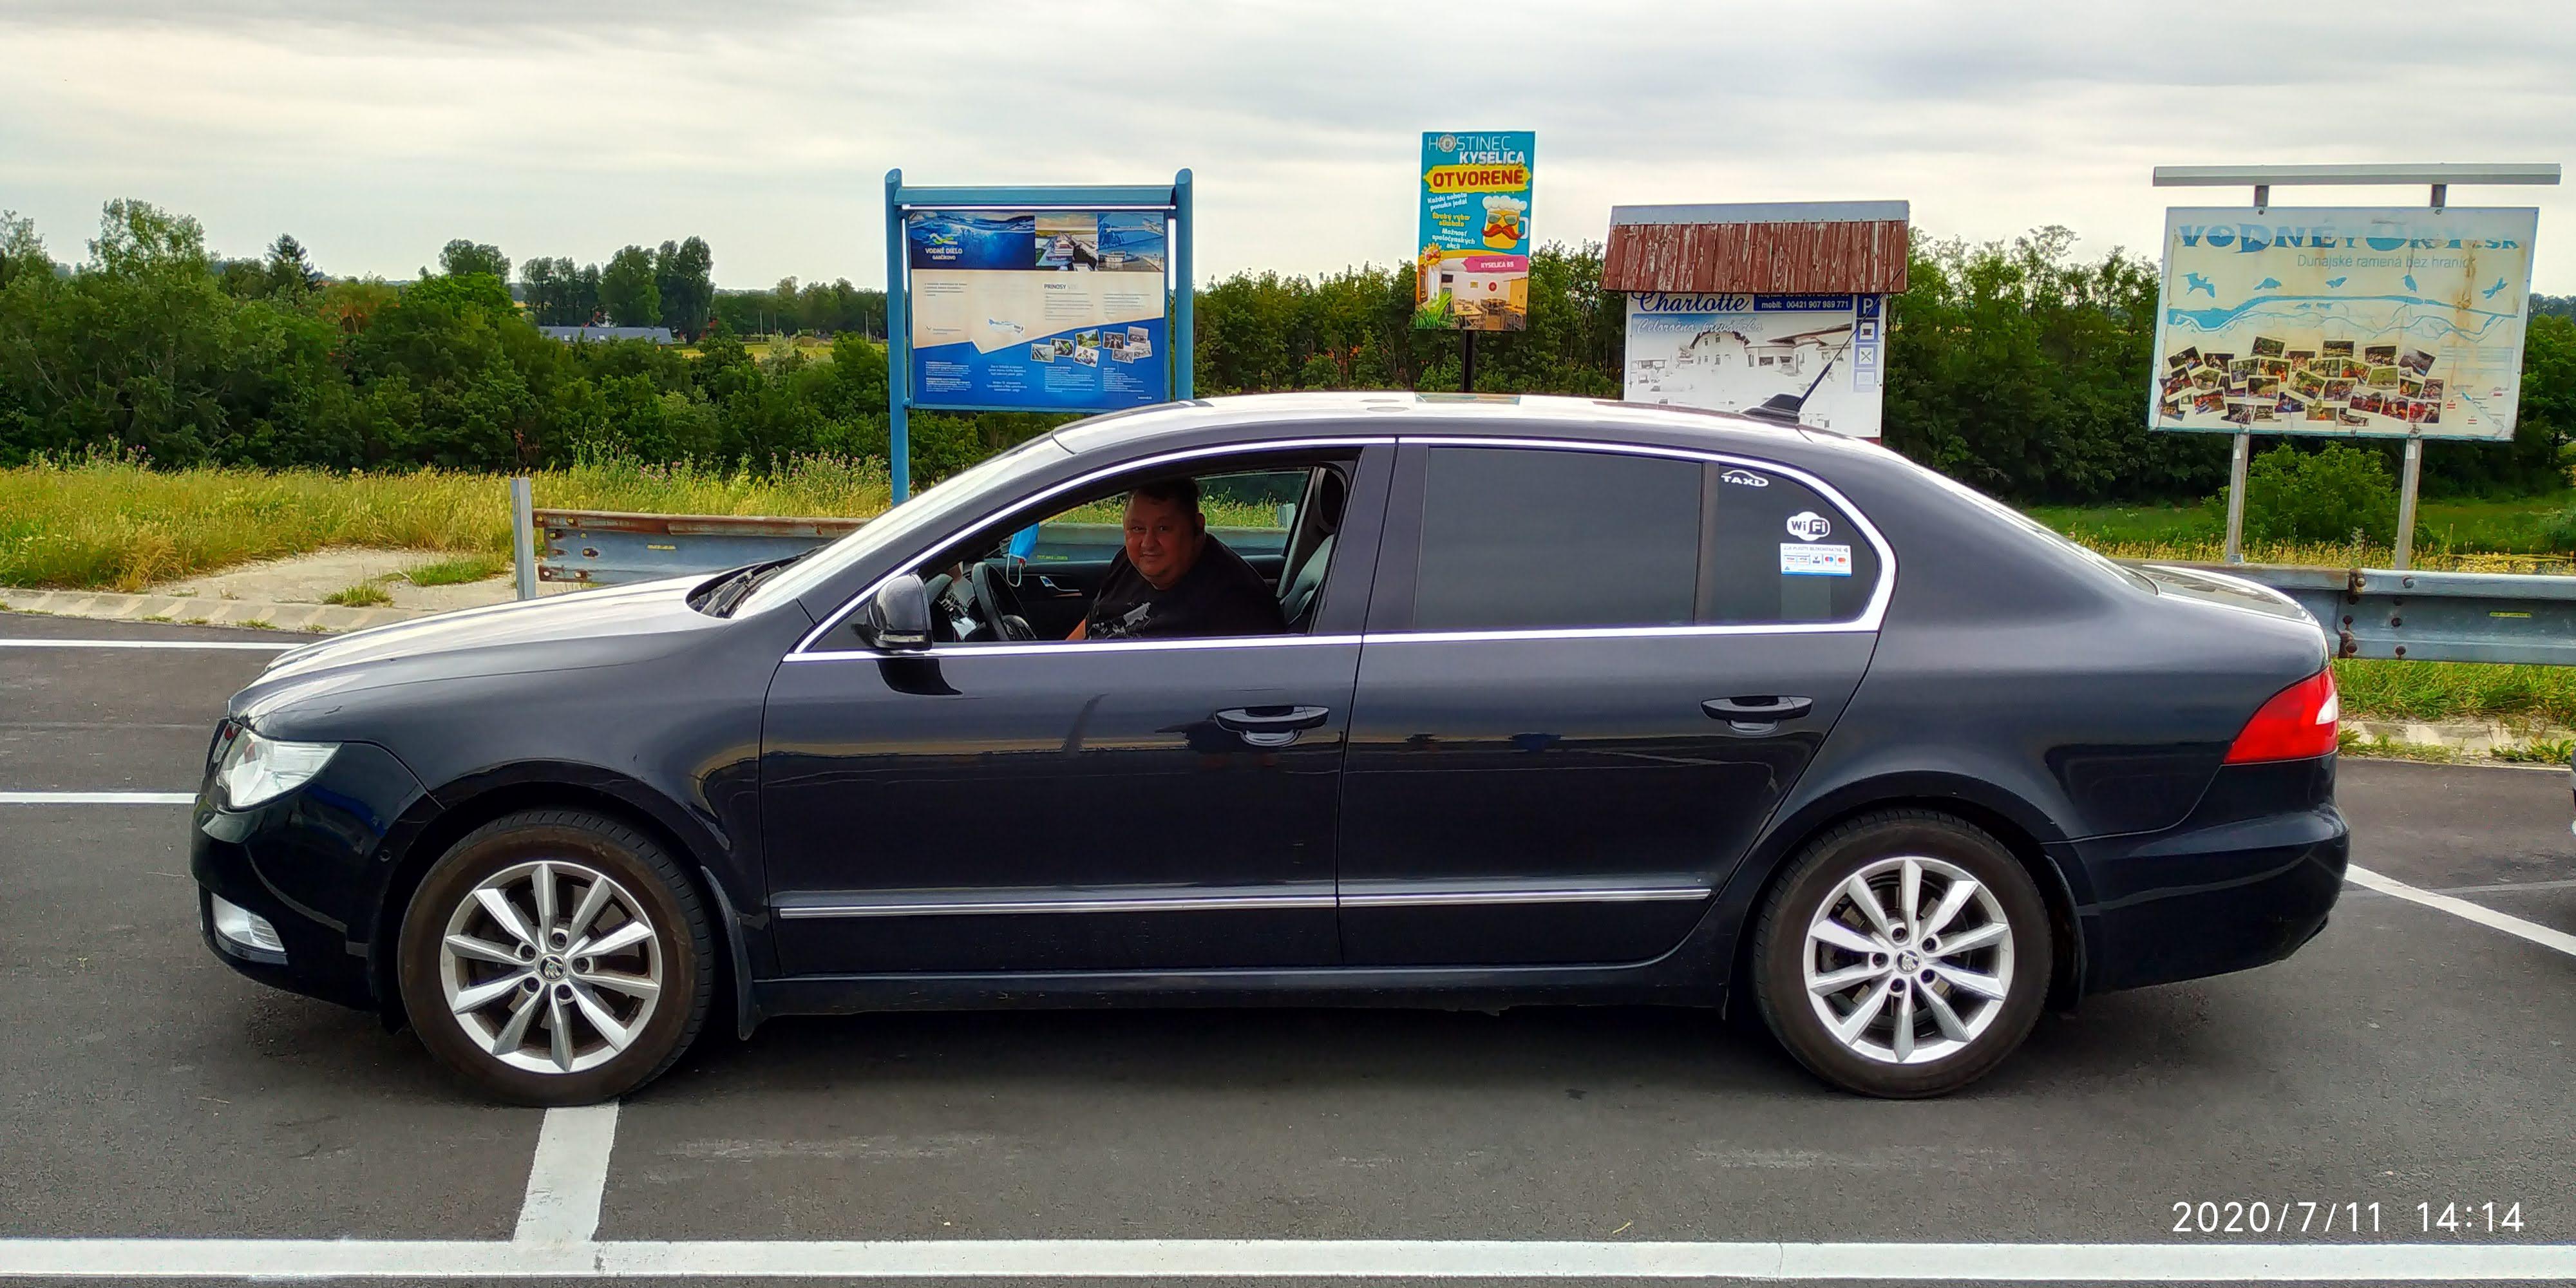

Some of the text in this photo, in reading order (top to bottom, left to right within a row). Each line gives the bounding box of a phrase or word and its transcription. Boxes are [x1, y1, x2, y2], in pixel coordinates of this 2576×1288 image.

[1428, 134, 1511, 152] HOSTINEC
[1459, 151, 1525, 165] KYSELICA
[1433, 165, 1524, 187] OTVORENÉ
[1430, 201, 1452, 213] ponuka
[2298, 254, 2353, 269] Dunajské
[2356, 254, 2402, 268] ramená
[2405, 255, 2427, 268] bez
[1631, 292, 1750, 312] Charlotte
[1786, 300, 1806, 308] 00421
[1808, 300, 1821, 308] 907
[1837, 300, 1849, 308] 771
[1863, 298, 1873, 314] P
[1637, 318, 1696, 334] Celoročná
[1721, 475, 1760, 486] TAXI
